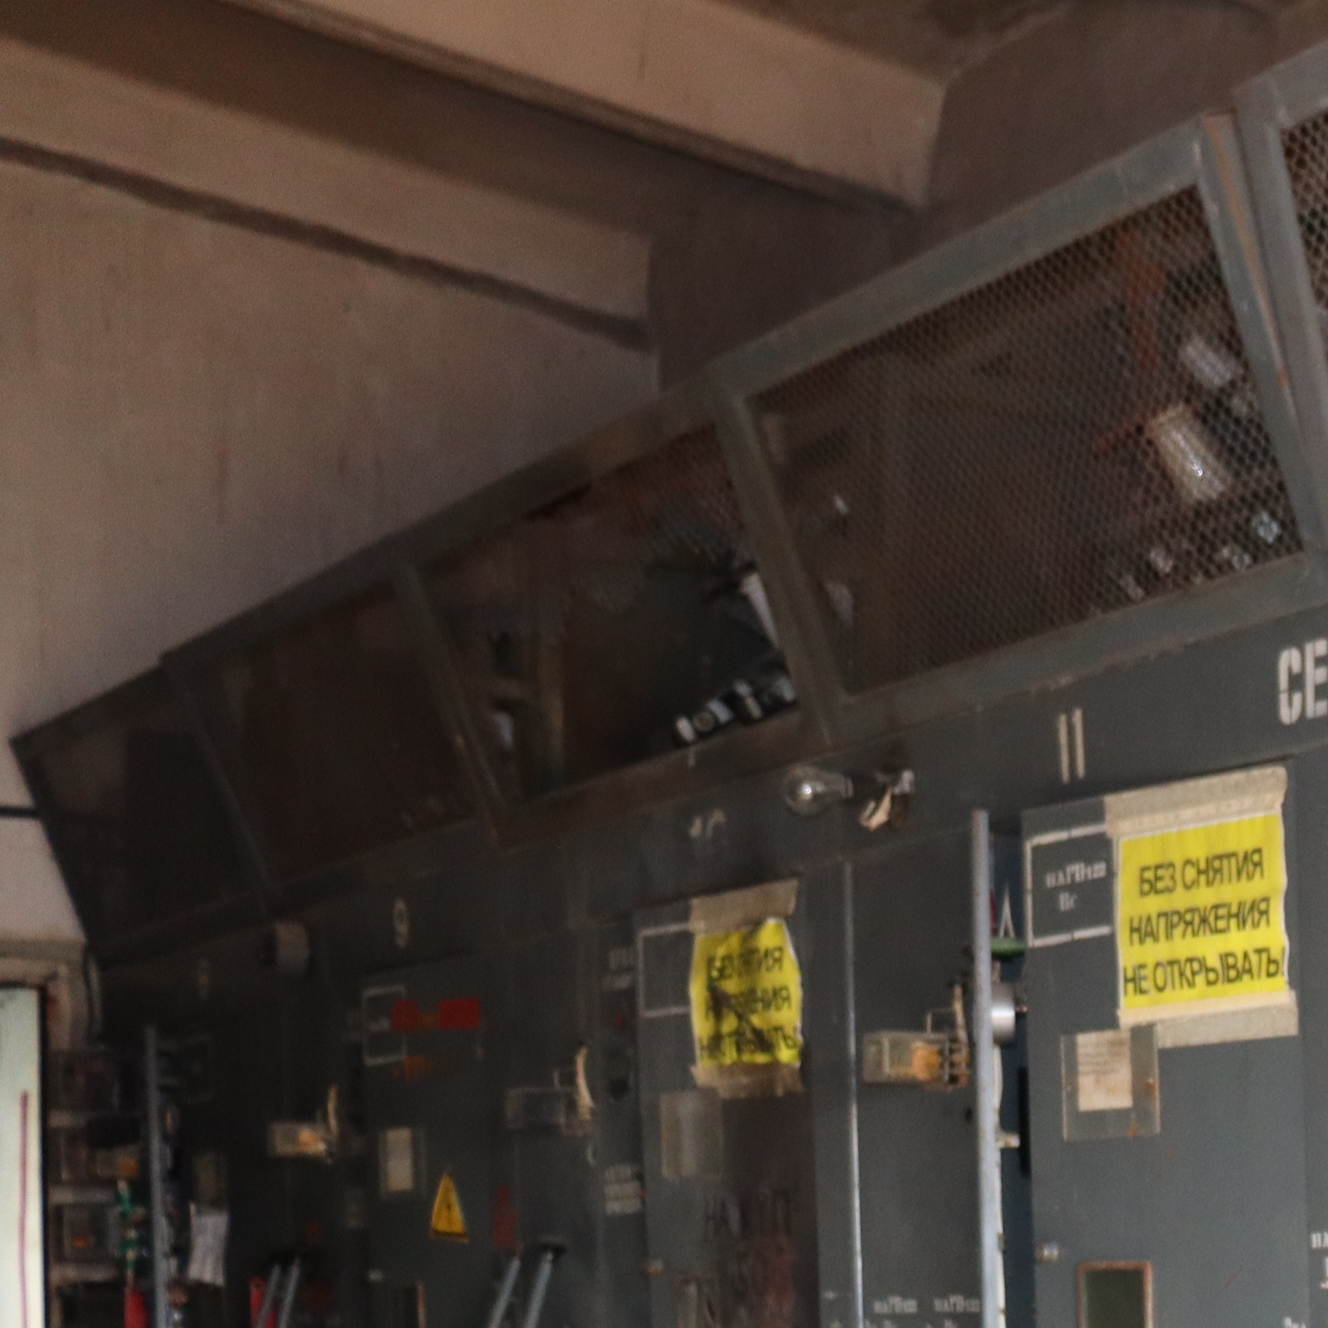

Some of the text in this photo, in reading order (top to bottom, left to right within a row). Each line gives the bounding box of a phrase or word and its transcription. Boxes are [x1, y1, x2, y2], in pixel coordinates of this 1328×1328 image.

[1139, 847, 1265, 898] БЕЗ СНЯТИЯ
[1128, 896, 1272, 946] НАПРЯЖЕНИЯ
[1123, 962, 1149, 996] НЕ
